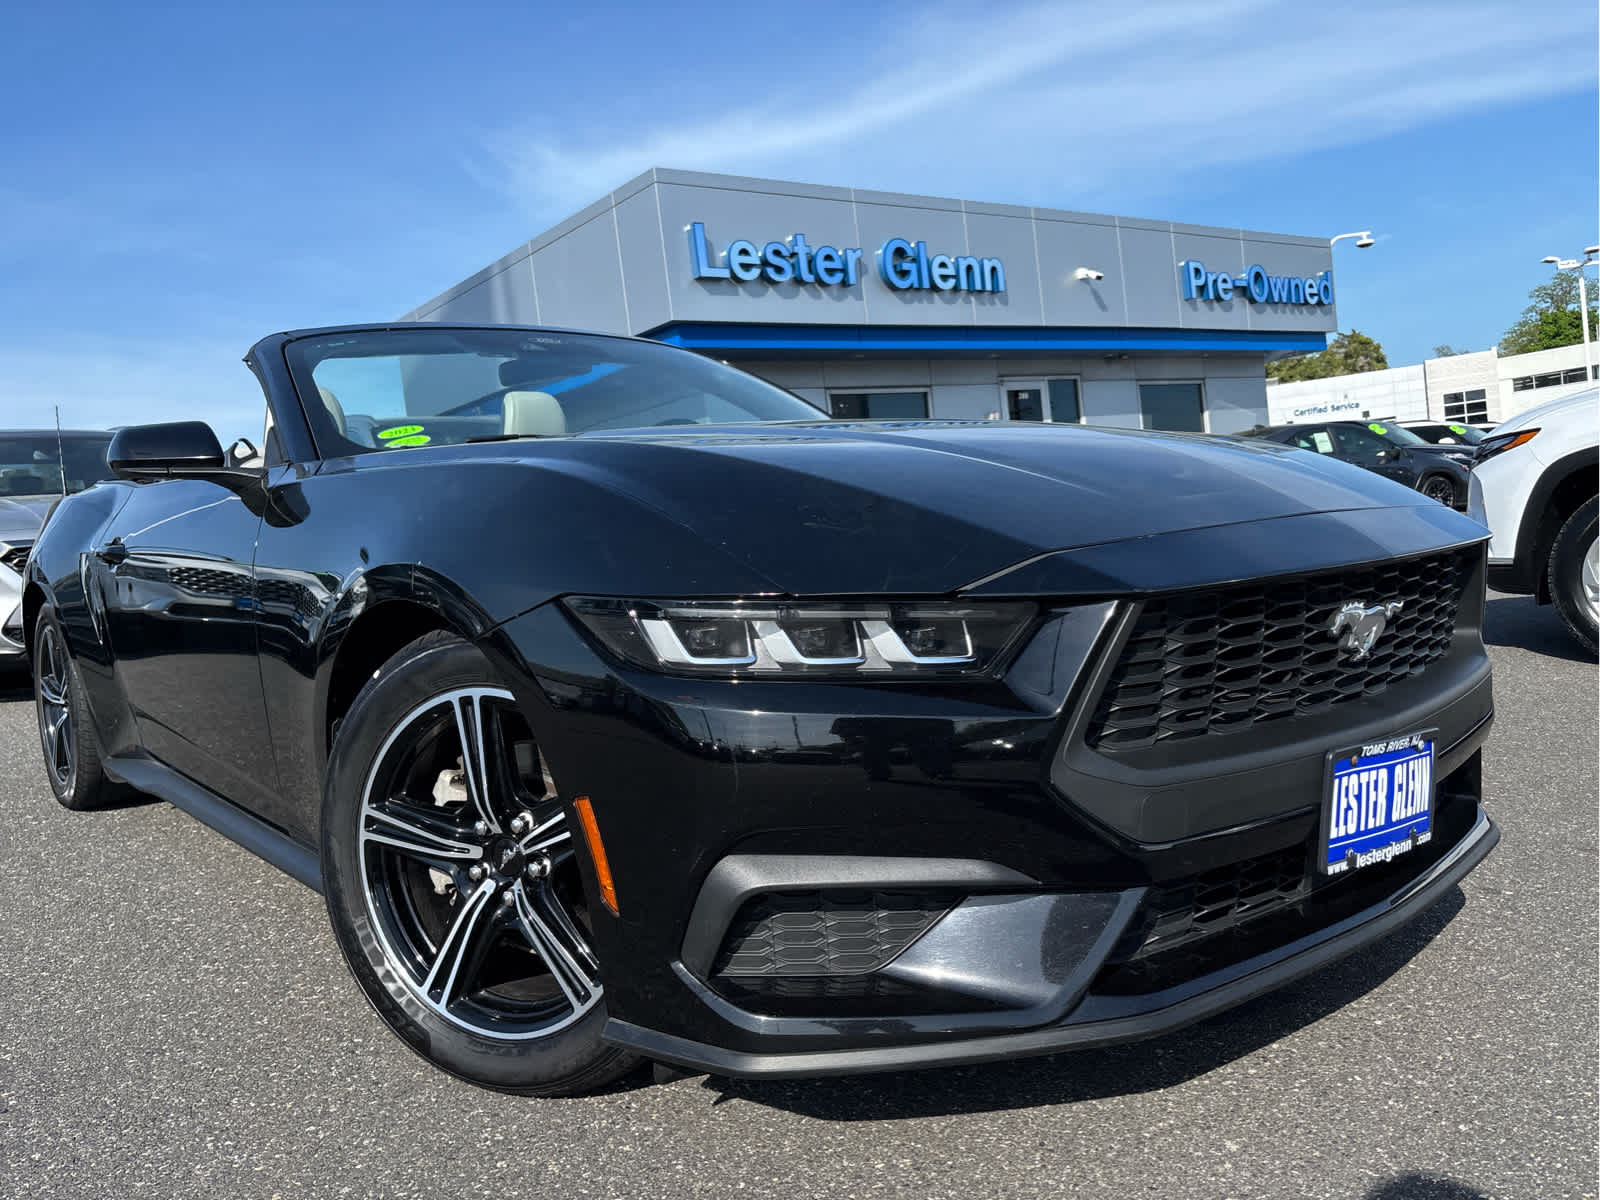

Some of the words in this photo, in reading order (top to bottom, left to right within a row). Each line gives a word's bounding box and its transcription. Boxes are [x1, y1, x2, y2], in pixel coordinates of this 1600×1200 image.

[689, 222, 863, 286] Lester
[879, 237, 1006, 293] Glenn
[1182, 260, 1335, 305] Pre-Owned
[1293, 406, 1328, 417] Certified
[1331, 402, 1360, 412] Service
[1361, 742, 1386, 757] TOMS
[1329, 768, 1388, 839] LESTER
[1391, 755, 1431, 823] GLENN
[1356, 839, 1412, 868] lesterglenn
